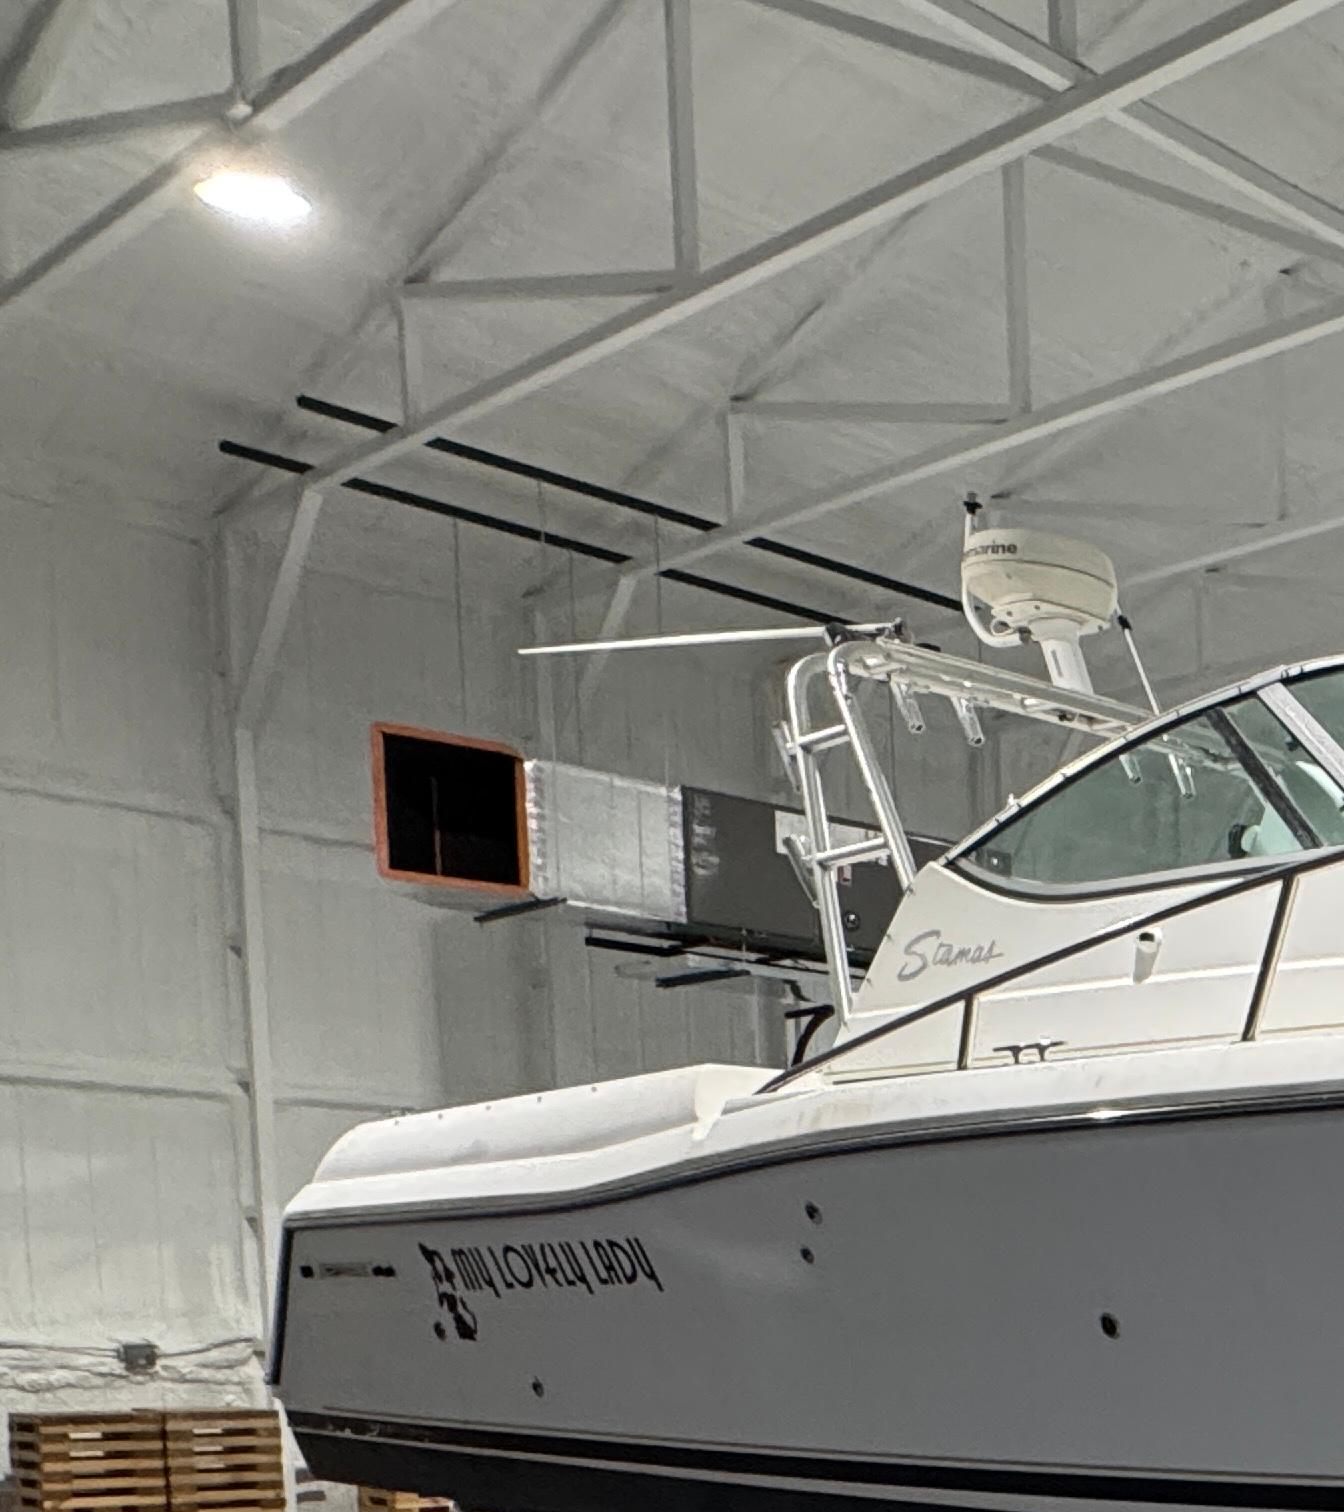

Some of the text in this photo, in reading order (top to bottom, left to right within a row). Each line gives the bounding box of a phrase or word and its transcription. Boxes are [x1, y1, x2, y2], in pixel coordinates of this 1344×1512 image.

[898, 930, 1004, 980] Stamas
[488, 1243, 594, 1295] LOVELY
[580, 1237, 665, 1292] LADY
